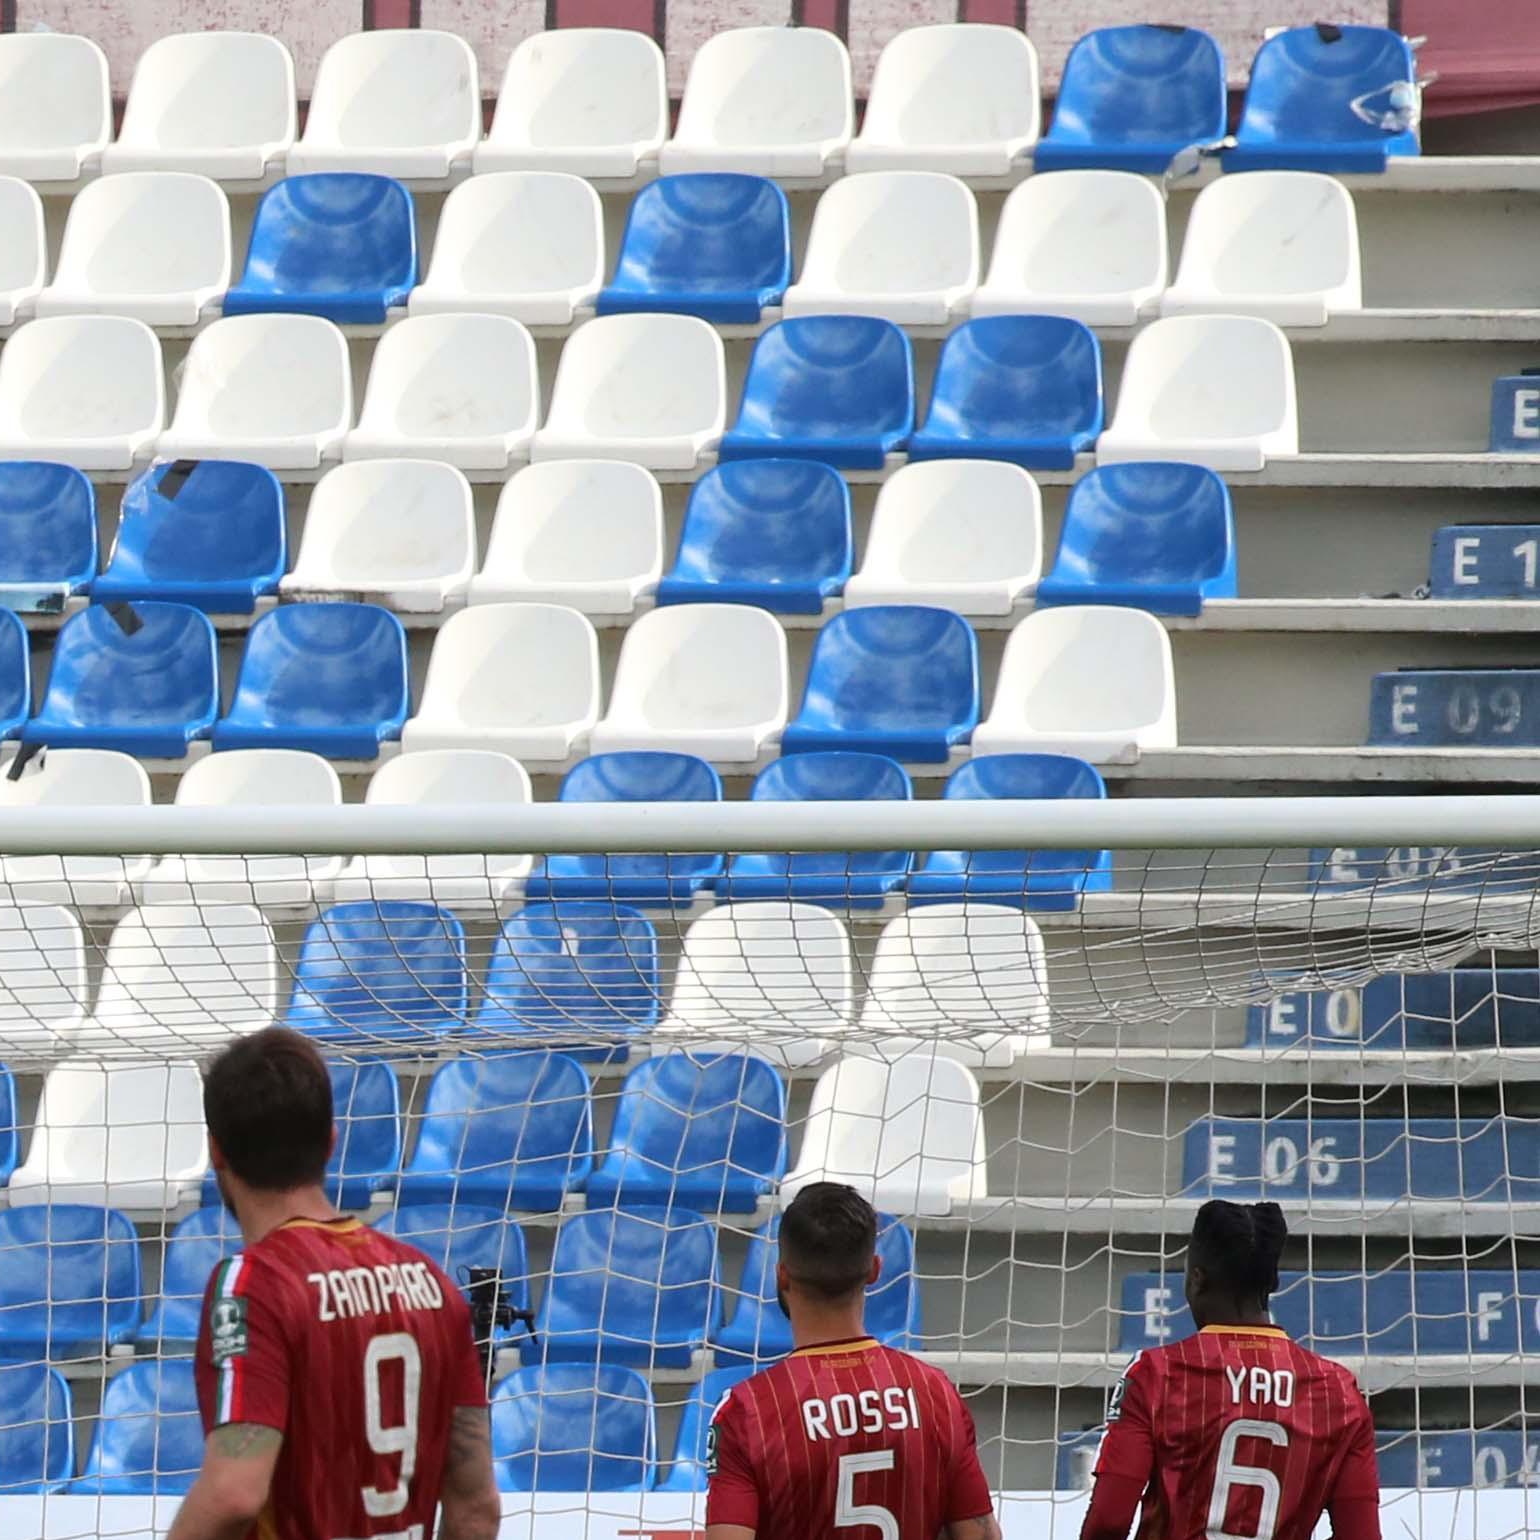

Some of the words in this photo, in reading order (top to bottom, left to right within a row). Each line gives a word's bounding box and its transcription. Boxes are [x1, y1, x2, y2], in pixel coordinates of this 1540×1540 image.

[1453, 537, 1481, 585] E
[1392, 684, 1420, 735] E
[1448, 684, 1523, 734] 09
[1270, 991, 1297, 1034] E
[1209, 1135, 1237, 1186] E
[1265, 1136, 1341, 1186] 06
[307, 1261, 444, 1322] ZAMPARO
[1144, 1287, 1173, 1338] E
[1477, 1291, 1504, 1342] F
[1226, 1365, 1295, 1408] YAO
[360, 1331, 423, 1518] 9
[802, 1386, 921, 1442] ROSSI
